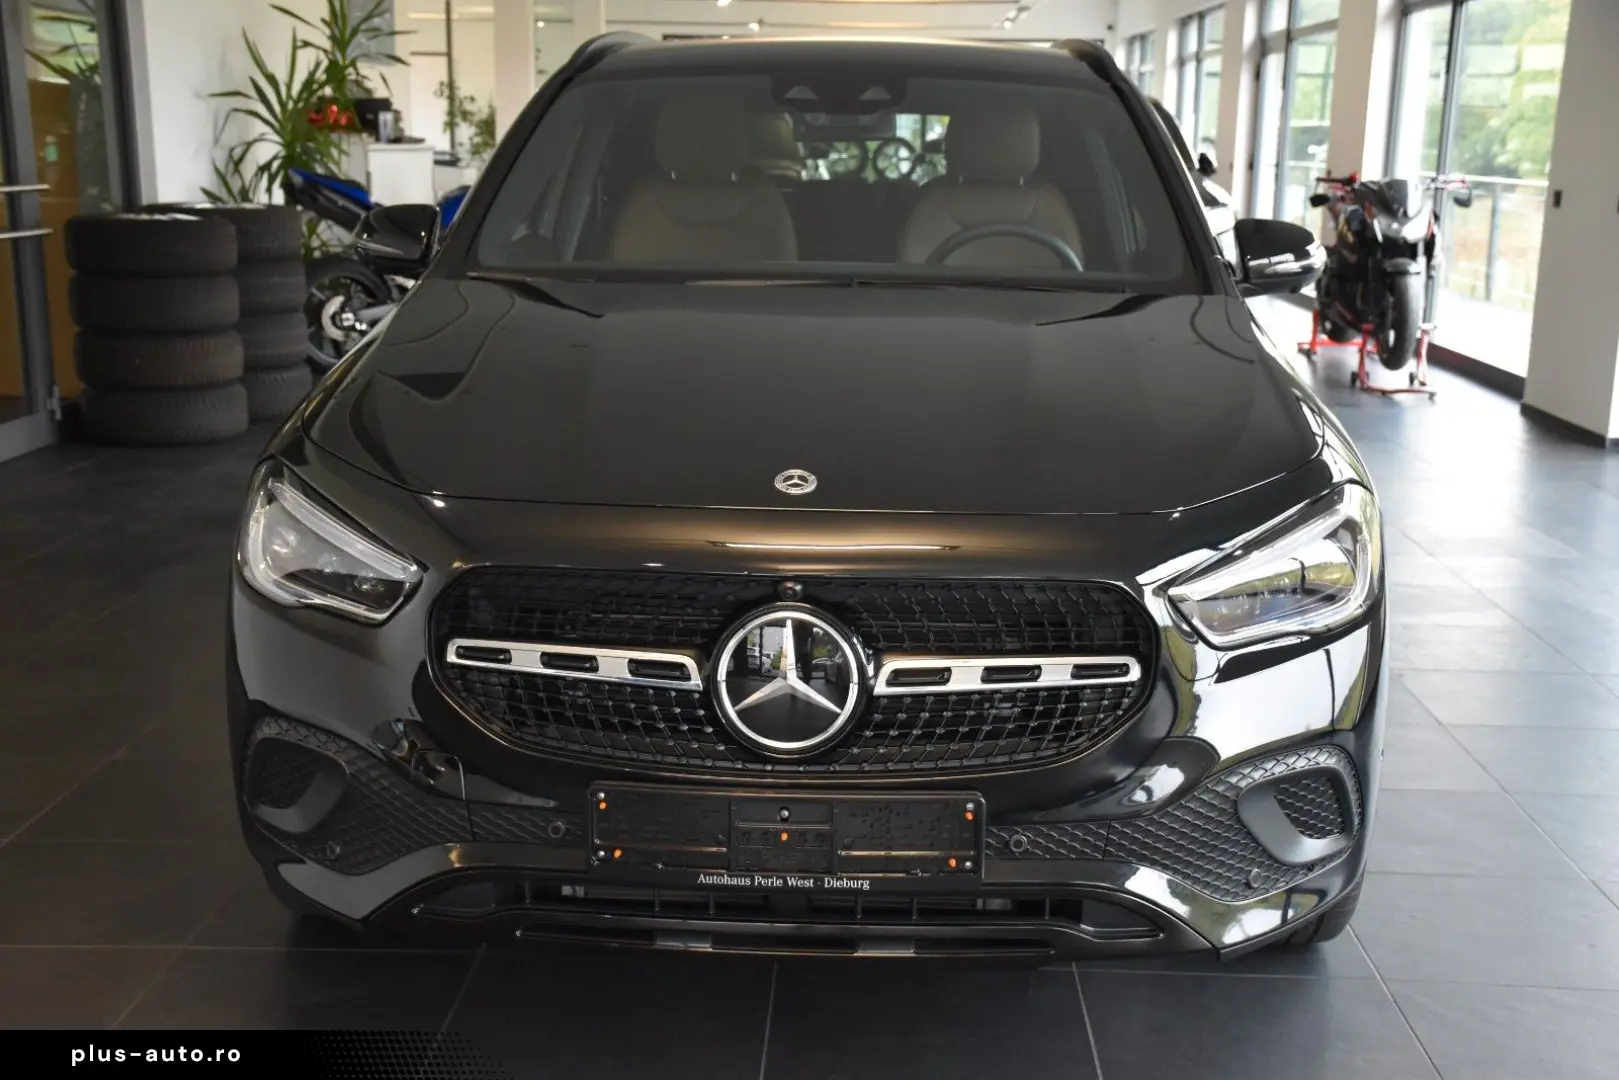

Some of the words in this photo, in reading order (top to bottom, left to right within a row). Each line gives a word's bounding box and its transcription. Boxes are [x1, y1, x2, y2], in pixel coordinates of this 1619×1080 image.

[697, 873, 751, 886] Autohaus
[754, 875, 783, 887] Perle
[786, 876, 814, 888] West
[824, 877, 870, 890] Dieburg
